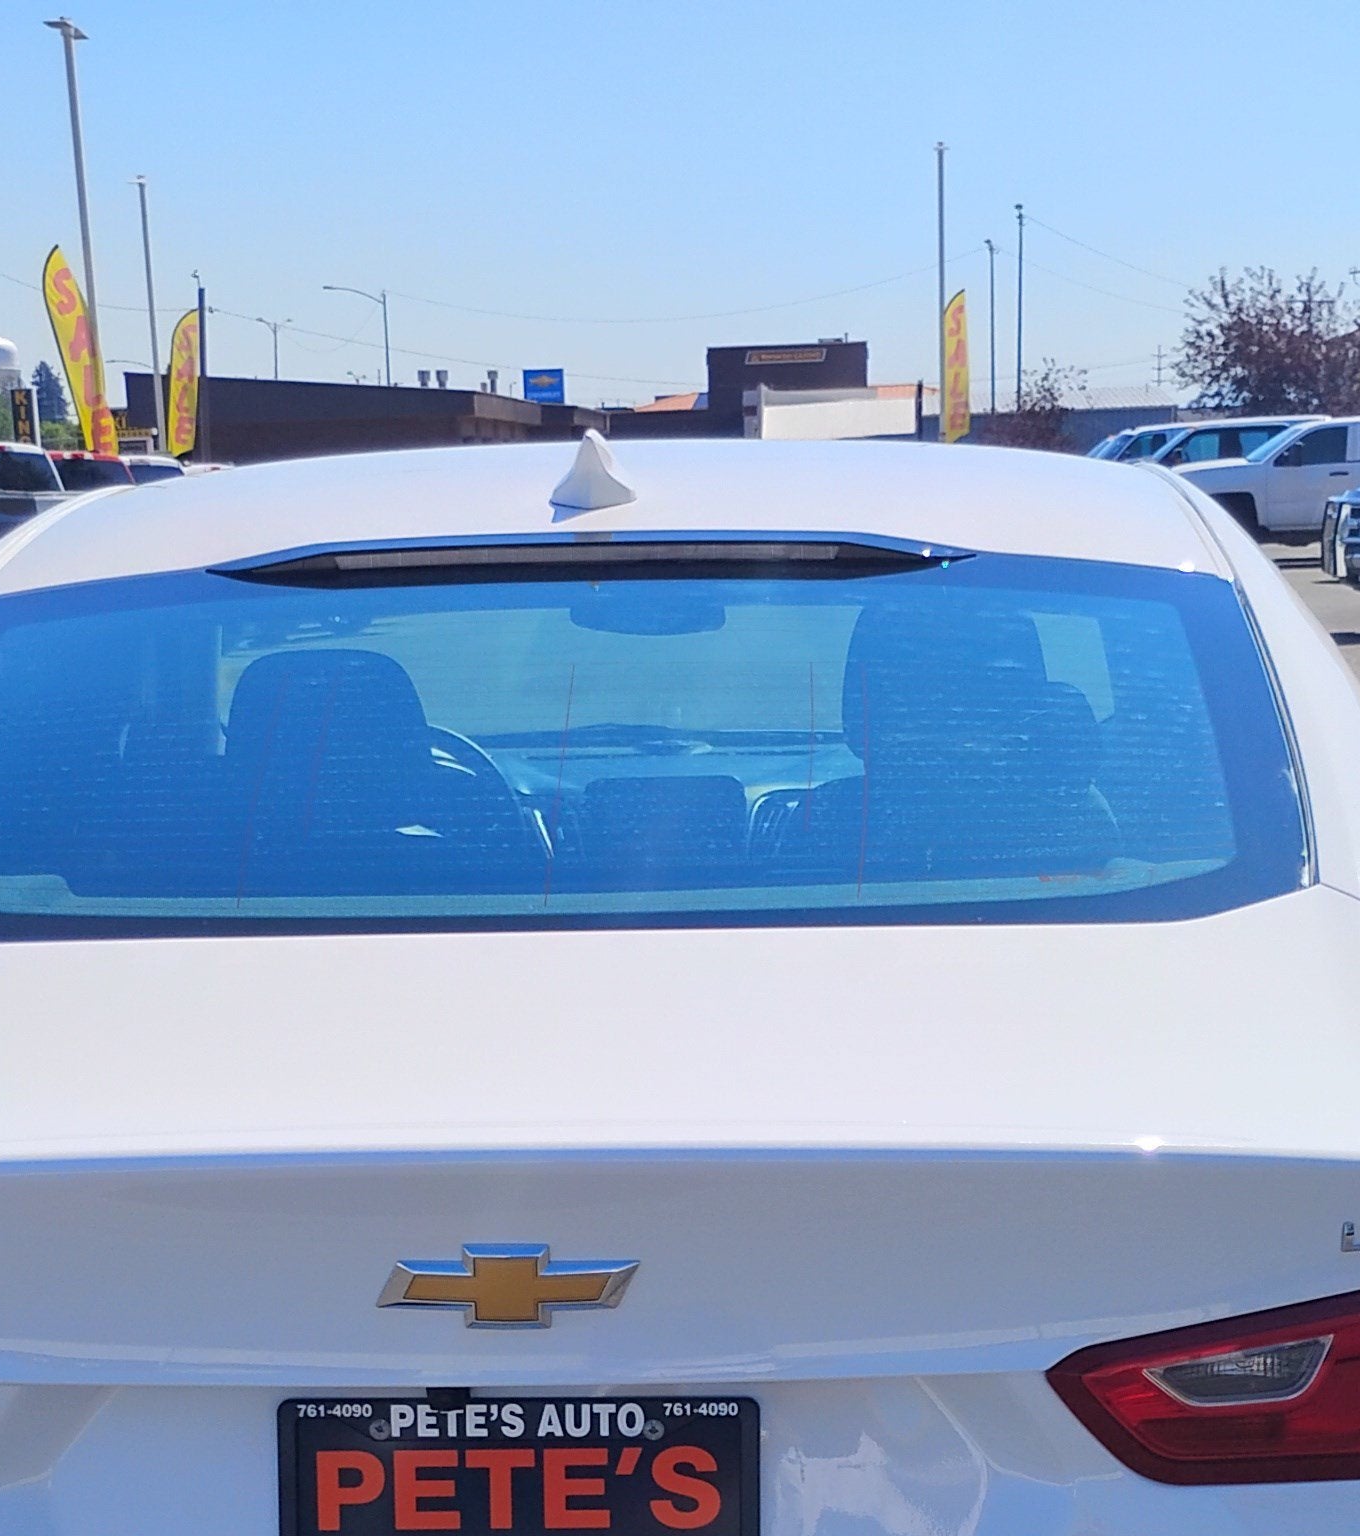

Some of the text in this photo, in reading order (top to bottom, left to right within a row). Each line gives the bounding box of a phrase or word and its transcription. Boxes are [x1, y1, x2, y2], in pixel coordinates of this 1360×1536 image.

[53, 267, 114, 455] SALE
[948, 305, 968, 430] SALE
[297, 1403, 372, 1418] 761-4090
[390, 1403, 645, 1438] PETE'S AUTO
[663, 1402, 738, 1417] 761-4090
[315, 1445, 722, 1531] PETE'S
